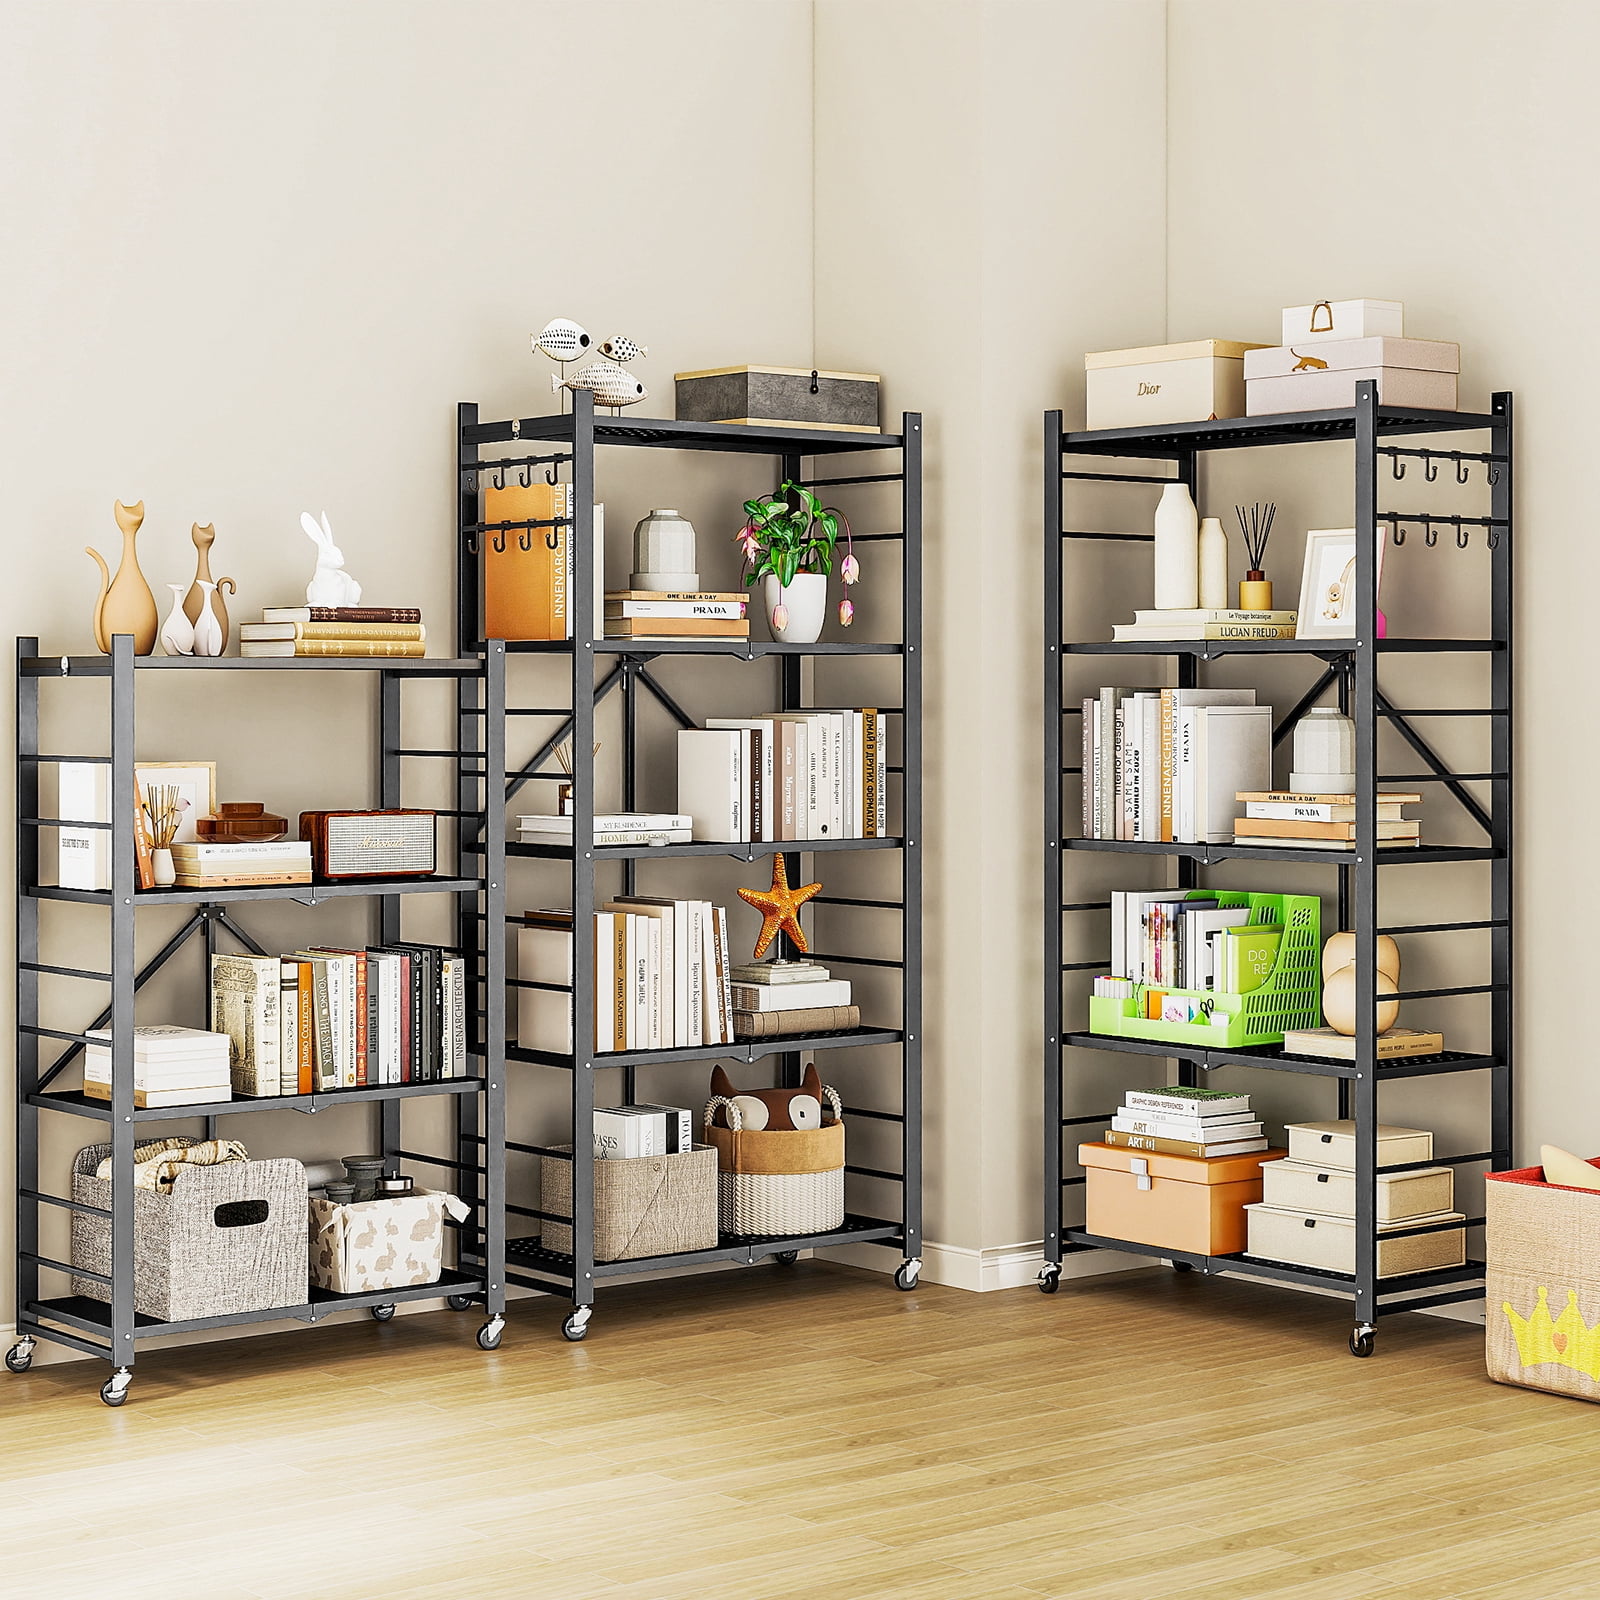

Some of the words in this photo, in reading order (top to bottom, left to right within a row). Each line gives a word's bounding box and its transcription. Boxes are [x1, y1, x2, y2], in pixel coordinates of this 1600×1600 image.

[1138, 382, 1161, 396] Dior
[554, 484, 564, 618] INNENARCHITKTUR
[693, 606, 727, 614] PRADA
[1251, 613, 1271, 621] botanique
[1220, 627, 1250, 637] LUCIAN
[1252, 628, 1277, 637] FREUD
[866, 713, 876, 742] ДУМАЙ
[1115, 714, 1123, 751] design
[1125, 742, 1133, 774] SAME
[1163, 689, 1172, 818] INNENARCHITEKTUR
[866, 752, 874, 783] ДРУГИХ
[1134, 776, 1139, 784] IN
[866, 786, 874, 829] ФОРМАТАХ
[1125, 781, 1133, 812] SAME
[1294, 808, 1320, 816] PRADA
[1248, 949, 1267, 962] DO
[318, 976, 327, 1008] YOUNG
[301, 990, 309, 1039] COLLECTION
[454, 966, 463, 1059] INNENARCHITEKTUR
[320, 1016, 330, 1035] THE
[301, 1041, 310, 1067] JUMBO
[322, 1036, 332, 1065] SHACK
[1132, 1097, 1147, 1106] GRAPHIC
[1148, 1099, 1160, 1107] DESIGN
[1161, 1101, 1184, 1110] REFERENCED
[682, 1116, 690, 1139] YOU
[1133, 1122, 1147, 1134] ART
[593, 1134, 618, 1149] VASES
[601, 1146, 608, 1158] &
[1128, 1136, 1144, 1148] ART
